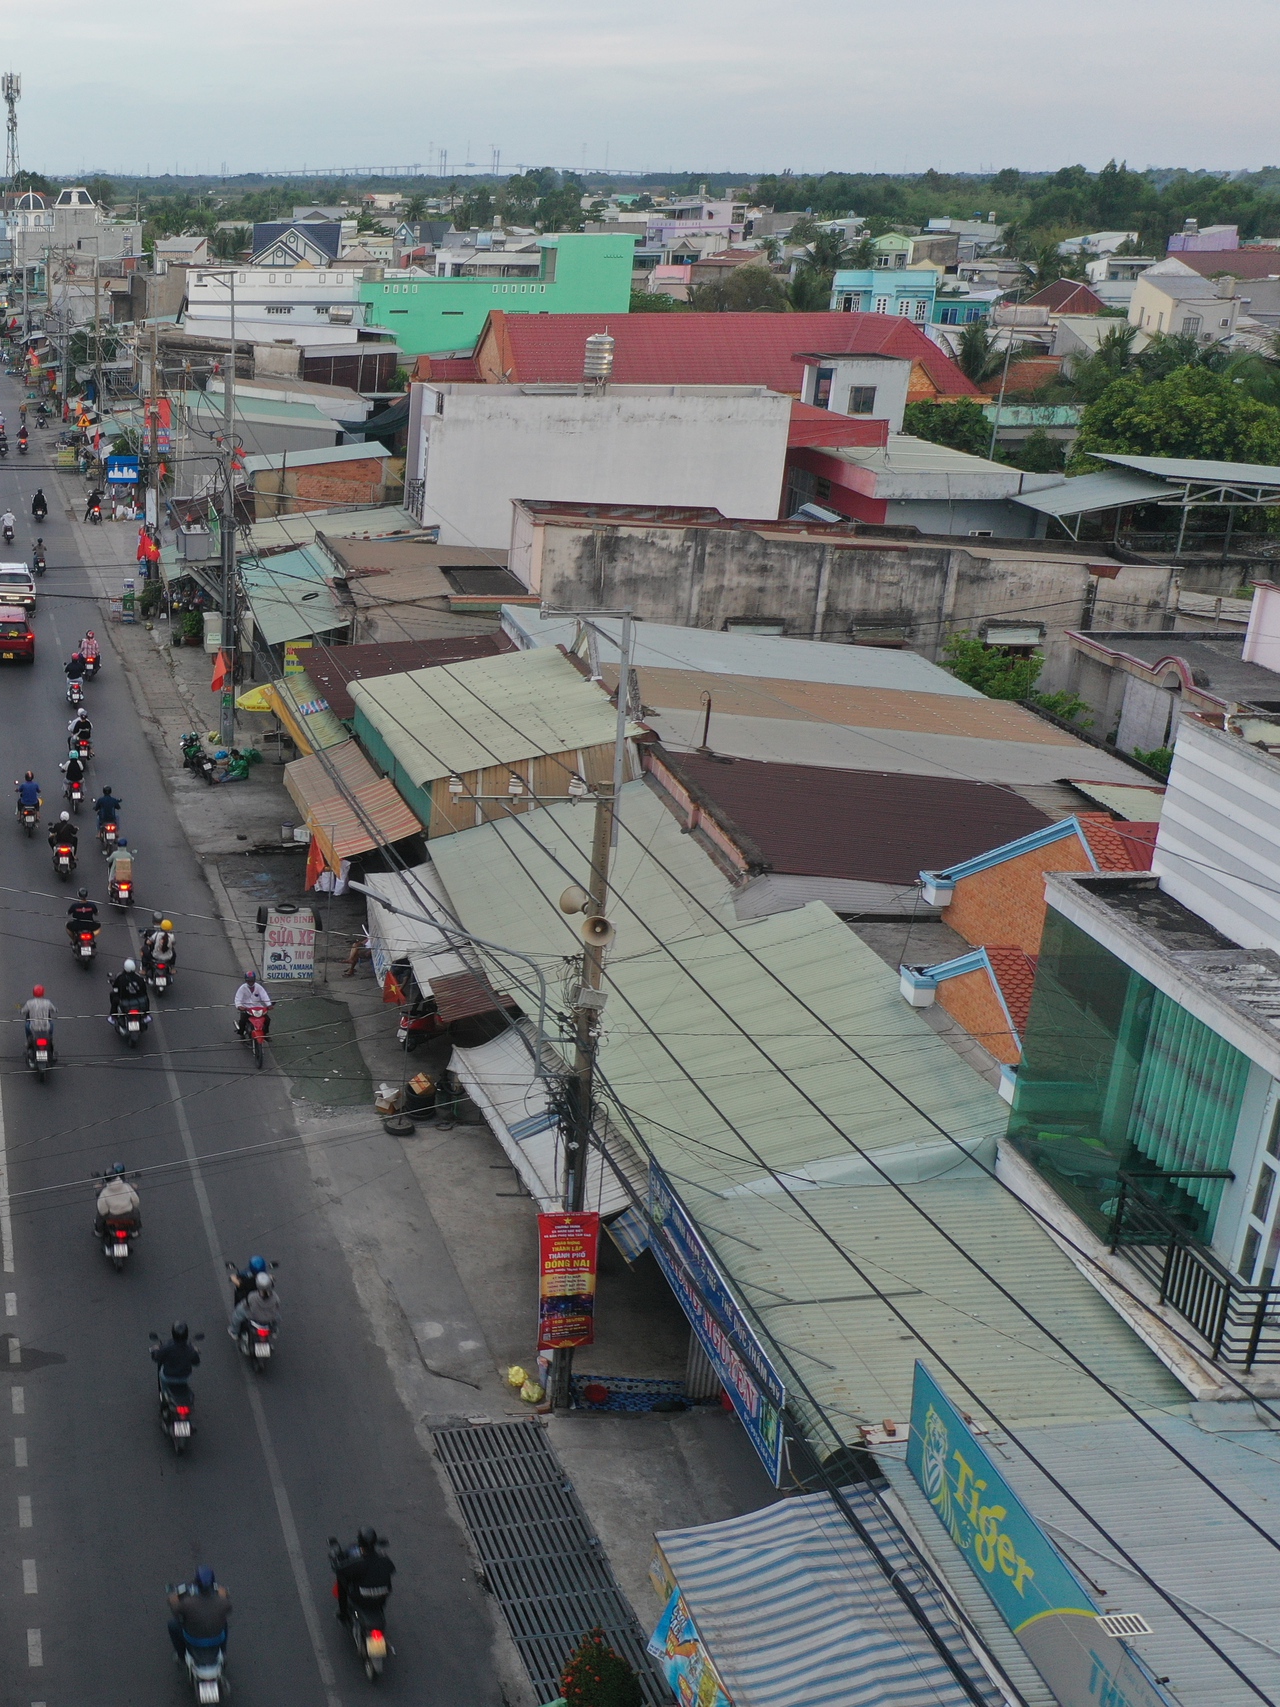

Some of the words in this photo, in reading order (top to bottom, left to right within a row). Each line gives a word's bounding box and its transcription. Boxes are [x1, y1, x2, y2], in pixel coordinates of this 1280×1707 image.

[269, 916, 291, 924] LONG
[268, 926, 294, 947] SỬA
[298, 930, 315, 946] XE
[294, 951, 305, 959] TAY
[544, 1259, 570, 1269] ĐỒNG
[573, 1259, 590, 1267] NAI
[953, 1448, 1035, 1600] Tiger
